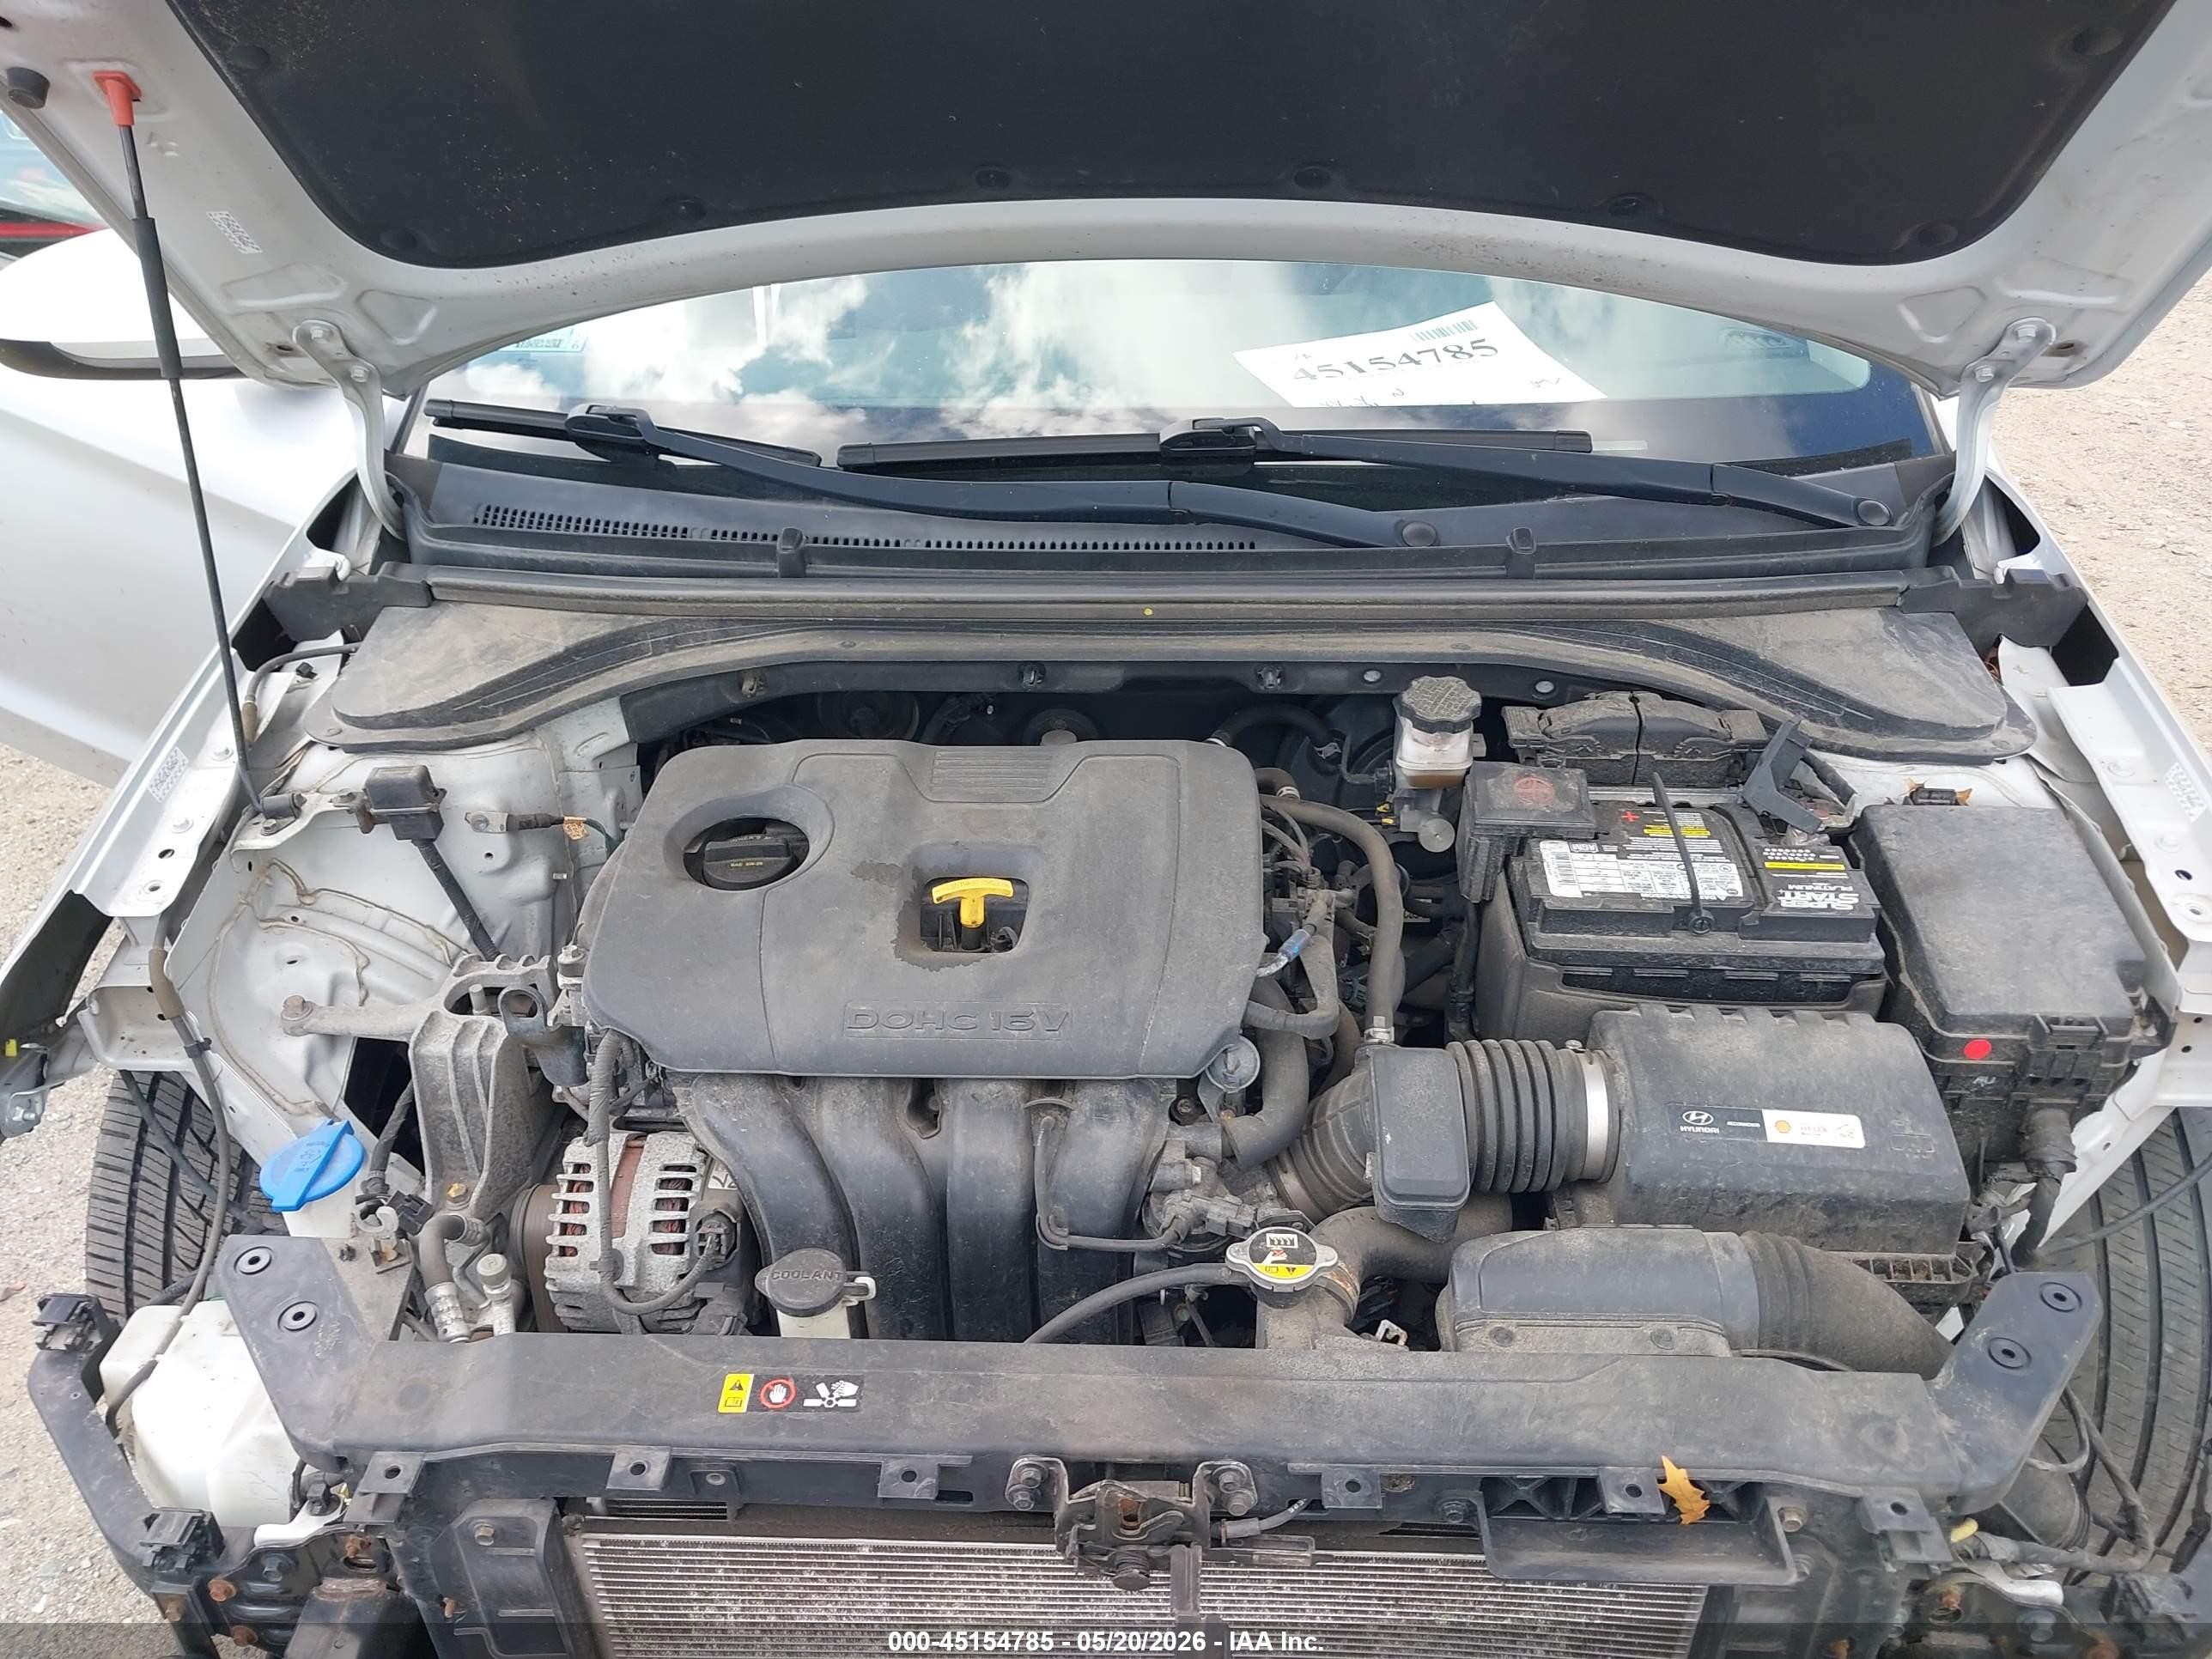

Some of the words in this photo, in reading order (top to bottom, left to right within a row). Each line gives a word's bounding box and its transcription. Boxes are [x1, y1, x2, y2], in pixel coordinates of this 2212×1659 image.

[1293, 338, 1498, 380] 45154785
[1777, 890, 1859, 904] START
[1780, 899, 1854, 910] SUPER
[847, 1006, 978, 1030] DOHC
[989, 1007, 1070, 1032] 16V
[1680, 1125, 1720, 1134] HYUNDAI
[771, 1270, 845, 1282] COOLANT
